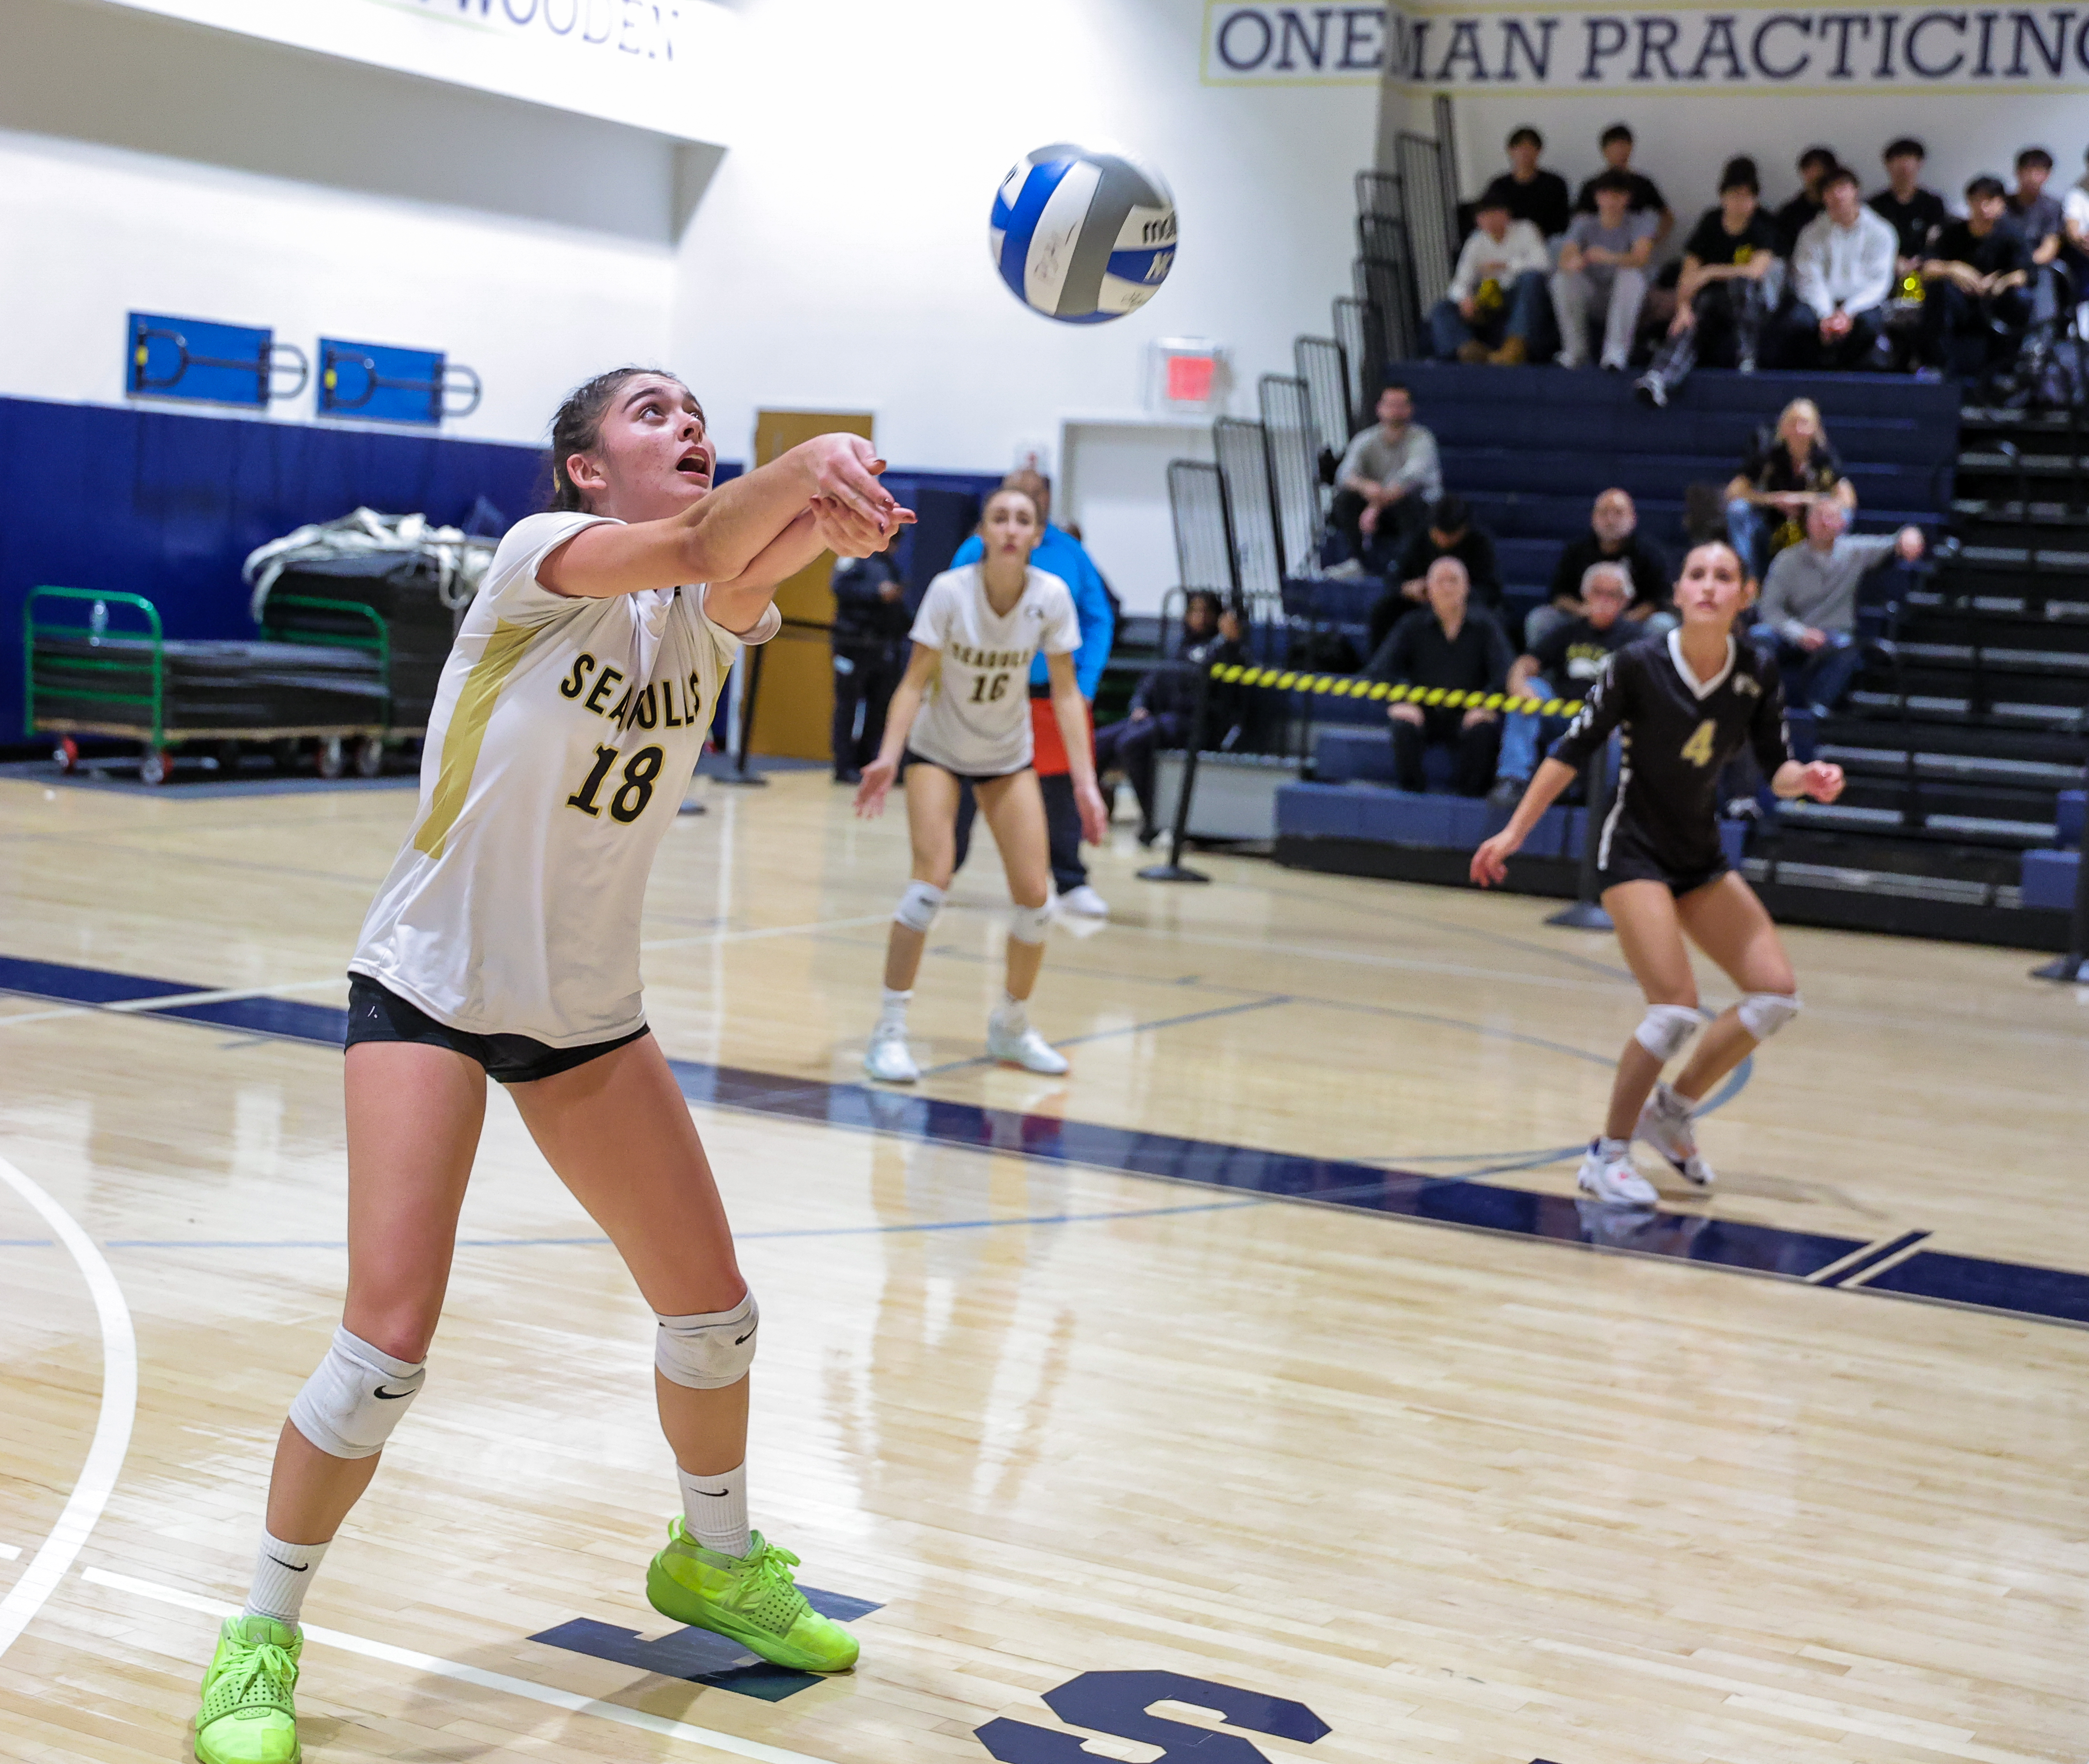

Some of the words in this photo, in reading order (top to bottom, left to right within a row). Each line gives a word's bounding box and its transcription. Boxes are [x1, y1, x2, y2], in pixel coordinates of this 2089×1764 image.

[454, 0, 681, 61] OODEN
[1215, 7, 1385, 71] ONE
[1393, 14, 1560, 81] MAN
[1577, 12, 2089, 81] PRACTICIN
[558, 651, 702, 732] SEAULLS
[968, 673, 1010, 704] 16
[1680, 718, 1717, 768] 4
[565, 742, 666, 826] 18
